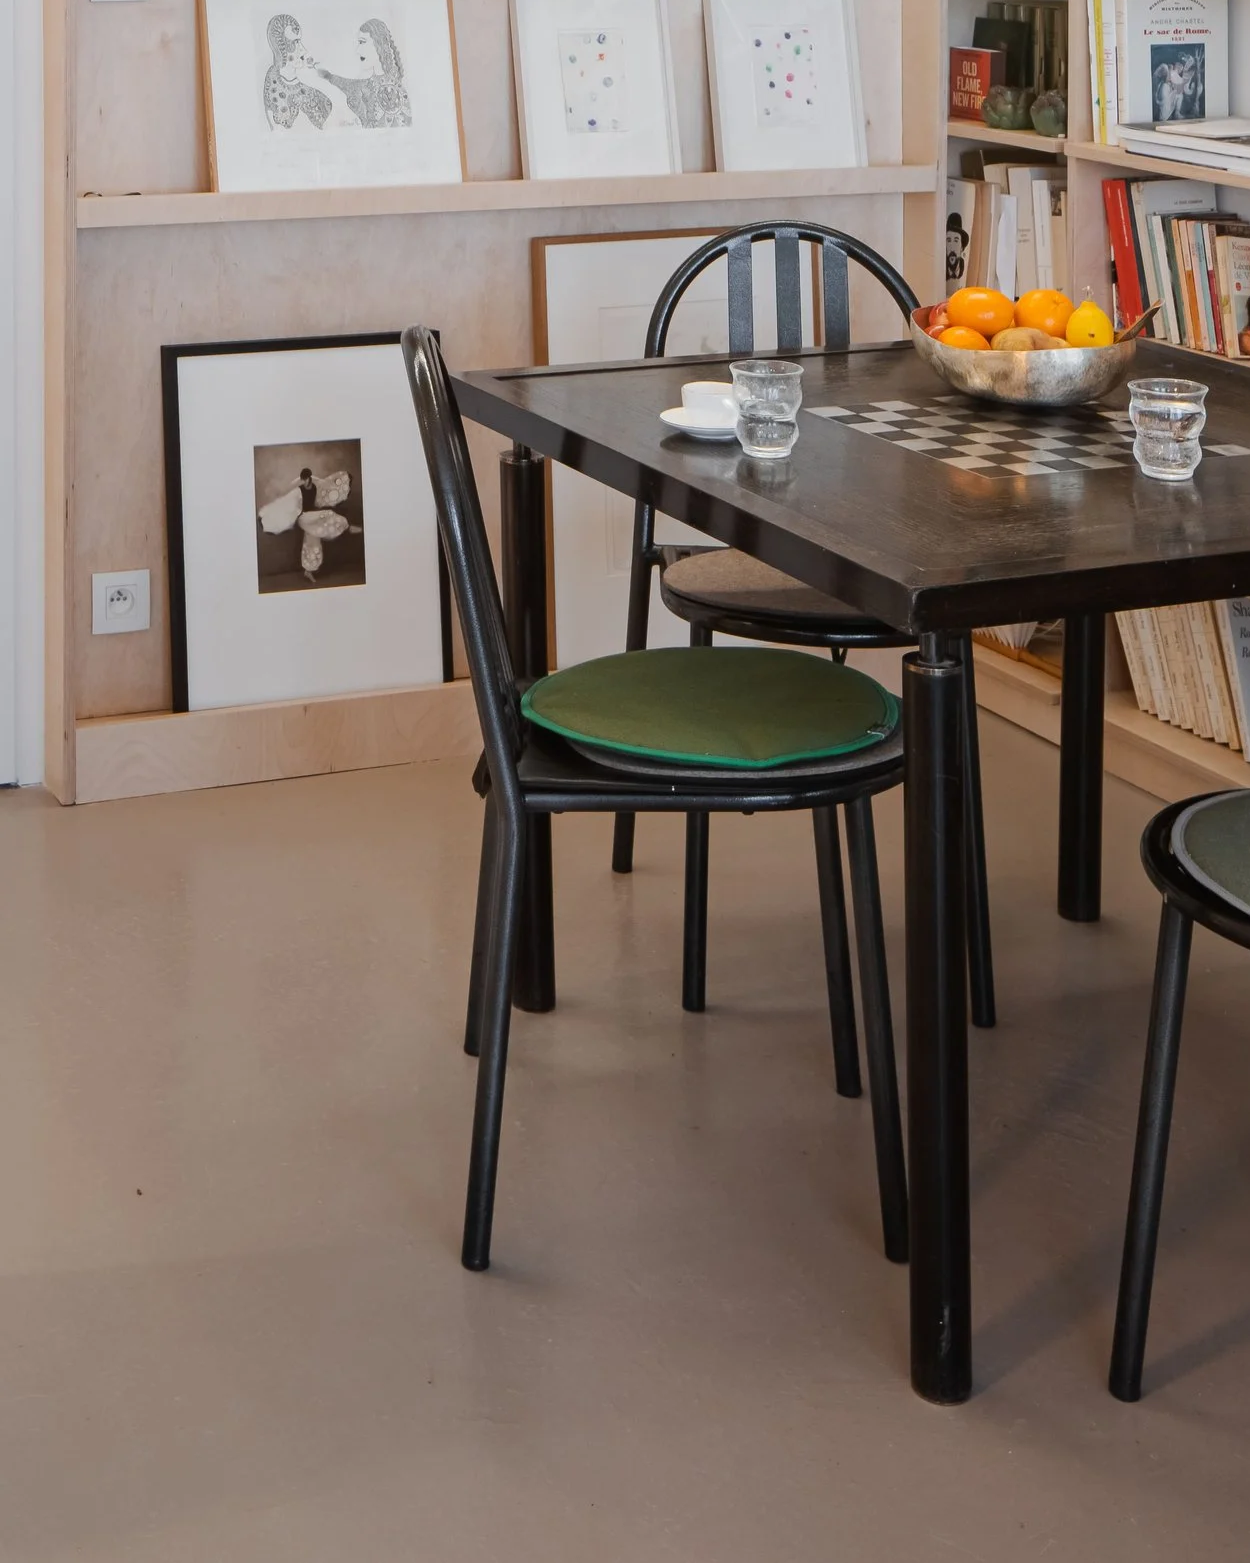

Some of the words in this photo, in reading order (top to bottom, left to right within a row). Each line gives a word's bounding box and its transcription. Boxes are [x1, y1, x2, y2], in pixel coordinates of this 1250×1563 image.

[962, 60, 978, 76] OLD
[956, 76, 983, 95] FLAME,
[952, 91, 969, 107] NEW
[1234, 270, 1244, 280] de
